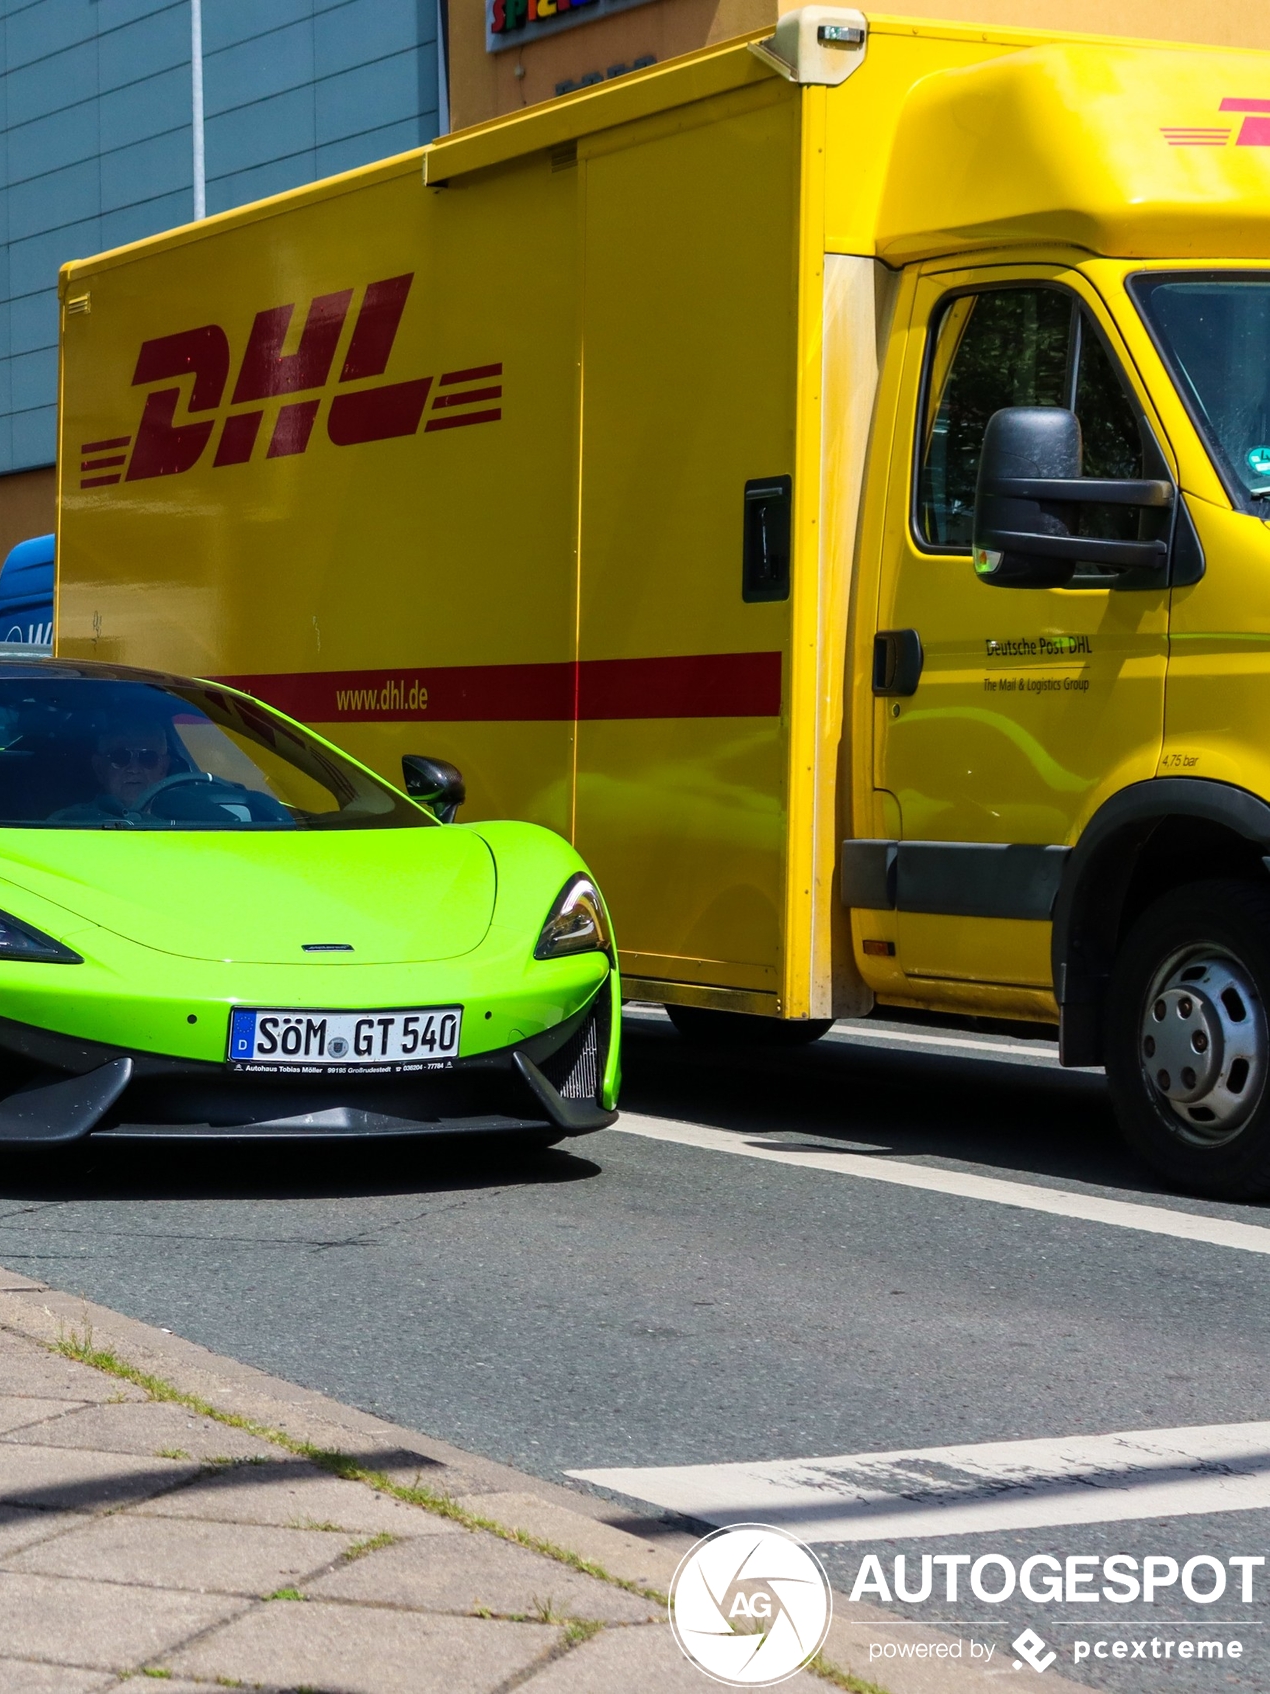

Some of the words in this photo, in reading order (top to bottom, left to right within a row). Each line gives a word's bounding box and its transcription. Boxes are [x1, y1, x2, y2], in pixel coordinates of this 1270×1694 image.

[491, 0, 593, 34] SPIE
[125, 272, 433, 482] DHL
[985, 637, 1037, 656] Deutsche
[1039, 637, 1065, 655] Post
[1068, 636, 1093, 654] DHL
[336, 679, 429, 711] www.dhl.de
[984, 678, 997, 691] The
[999, 678, 1017, 691] Mail
[1018, 678, 1025, 691] &
[1027, 677, 1062, 694] Logistics
[1063, 677, 1090, 693] Group
[1162, 754, 1182, 768] 4,75
[1182, 755, 1199, 767] bar
[238, 1039, 248, 1050] D
[354, 1018, 395, 1056] GT
[401, 1013, 457, 1054] 540
